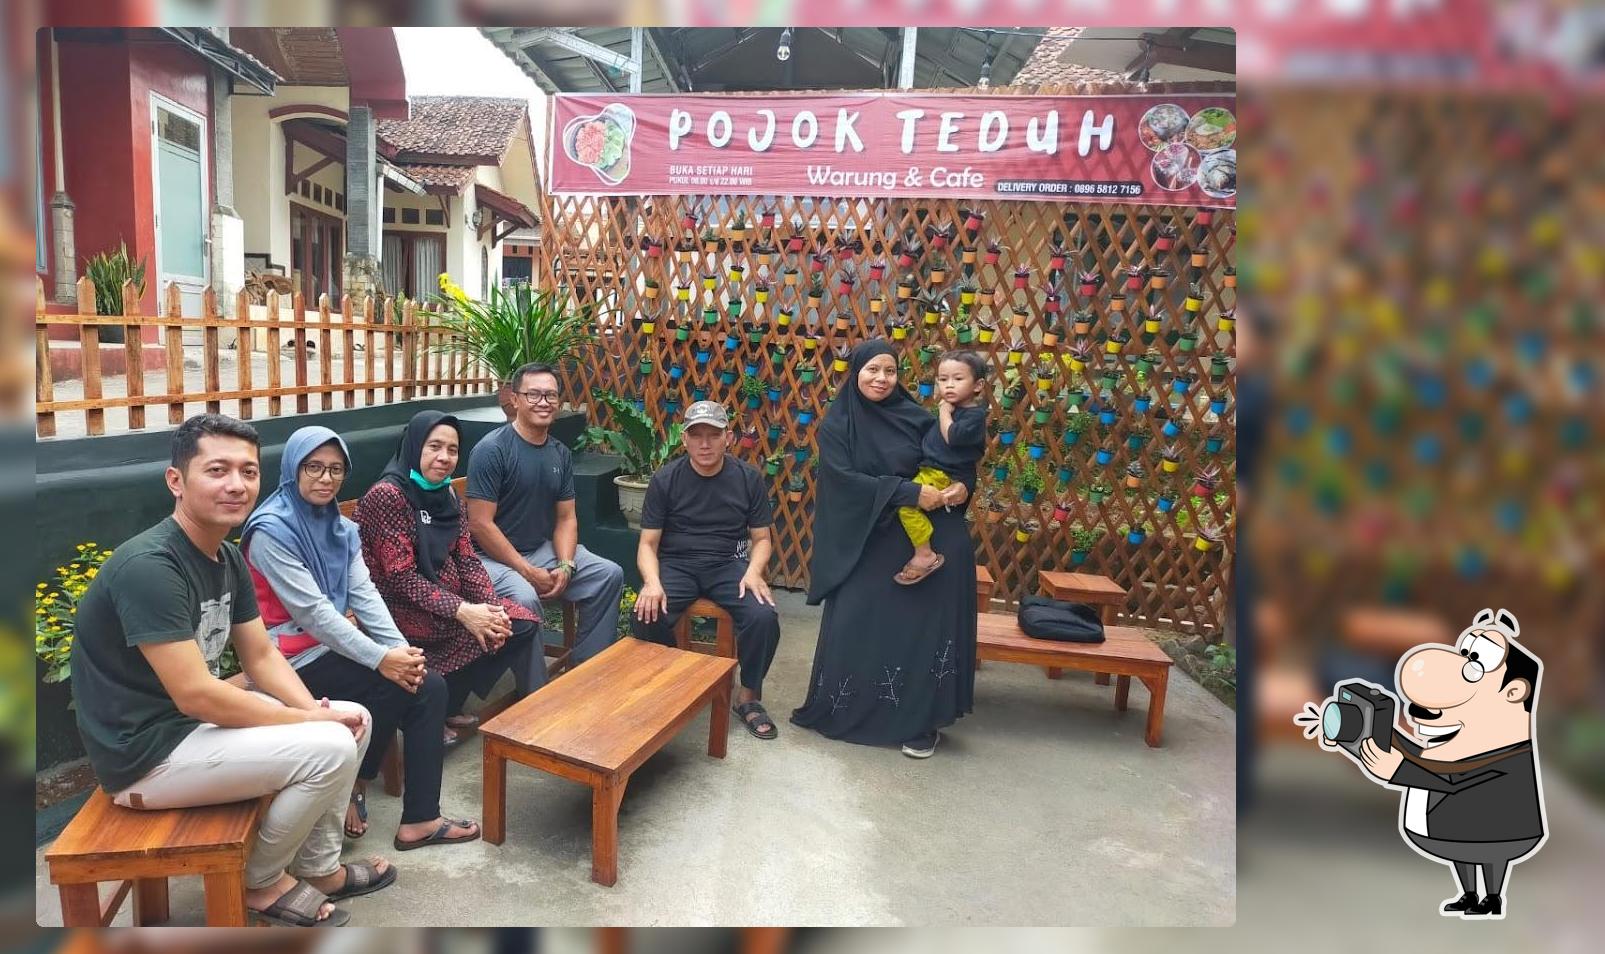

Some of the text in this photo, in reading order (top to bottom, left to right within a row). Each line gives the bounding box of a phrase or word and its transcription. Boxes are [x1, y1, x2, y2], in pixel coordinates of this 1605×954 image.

[669, 107, 1114, 157] POJOK TEDUH
[669, 165, 753, 176] BUKA SETIAP HARI
[807, 165, 984, 190] Warung & Cafe
[997, 182, 1038, 192] DELIVERY
[1038, 182, 1067, 193] ORDER
[1074, 183, 1095, 194] 0896
[1096, 184, 1118, 194] 5812
[1120, 184, 1141, 195] 7156
